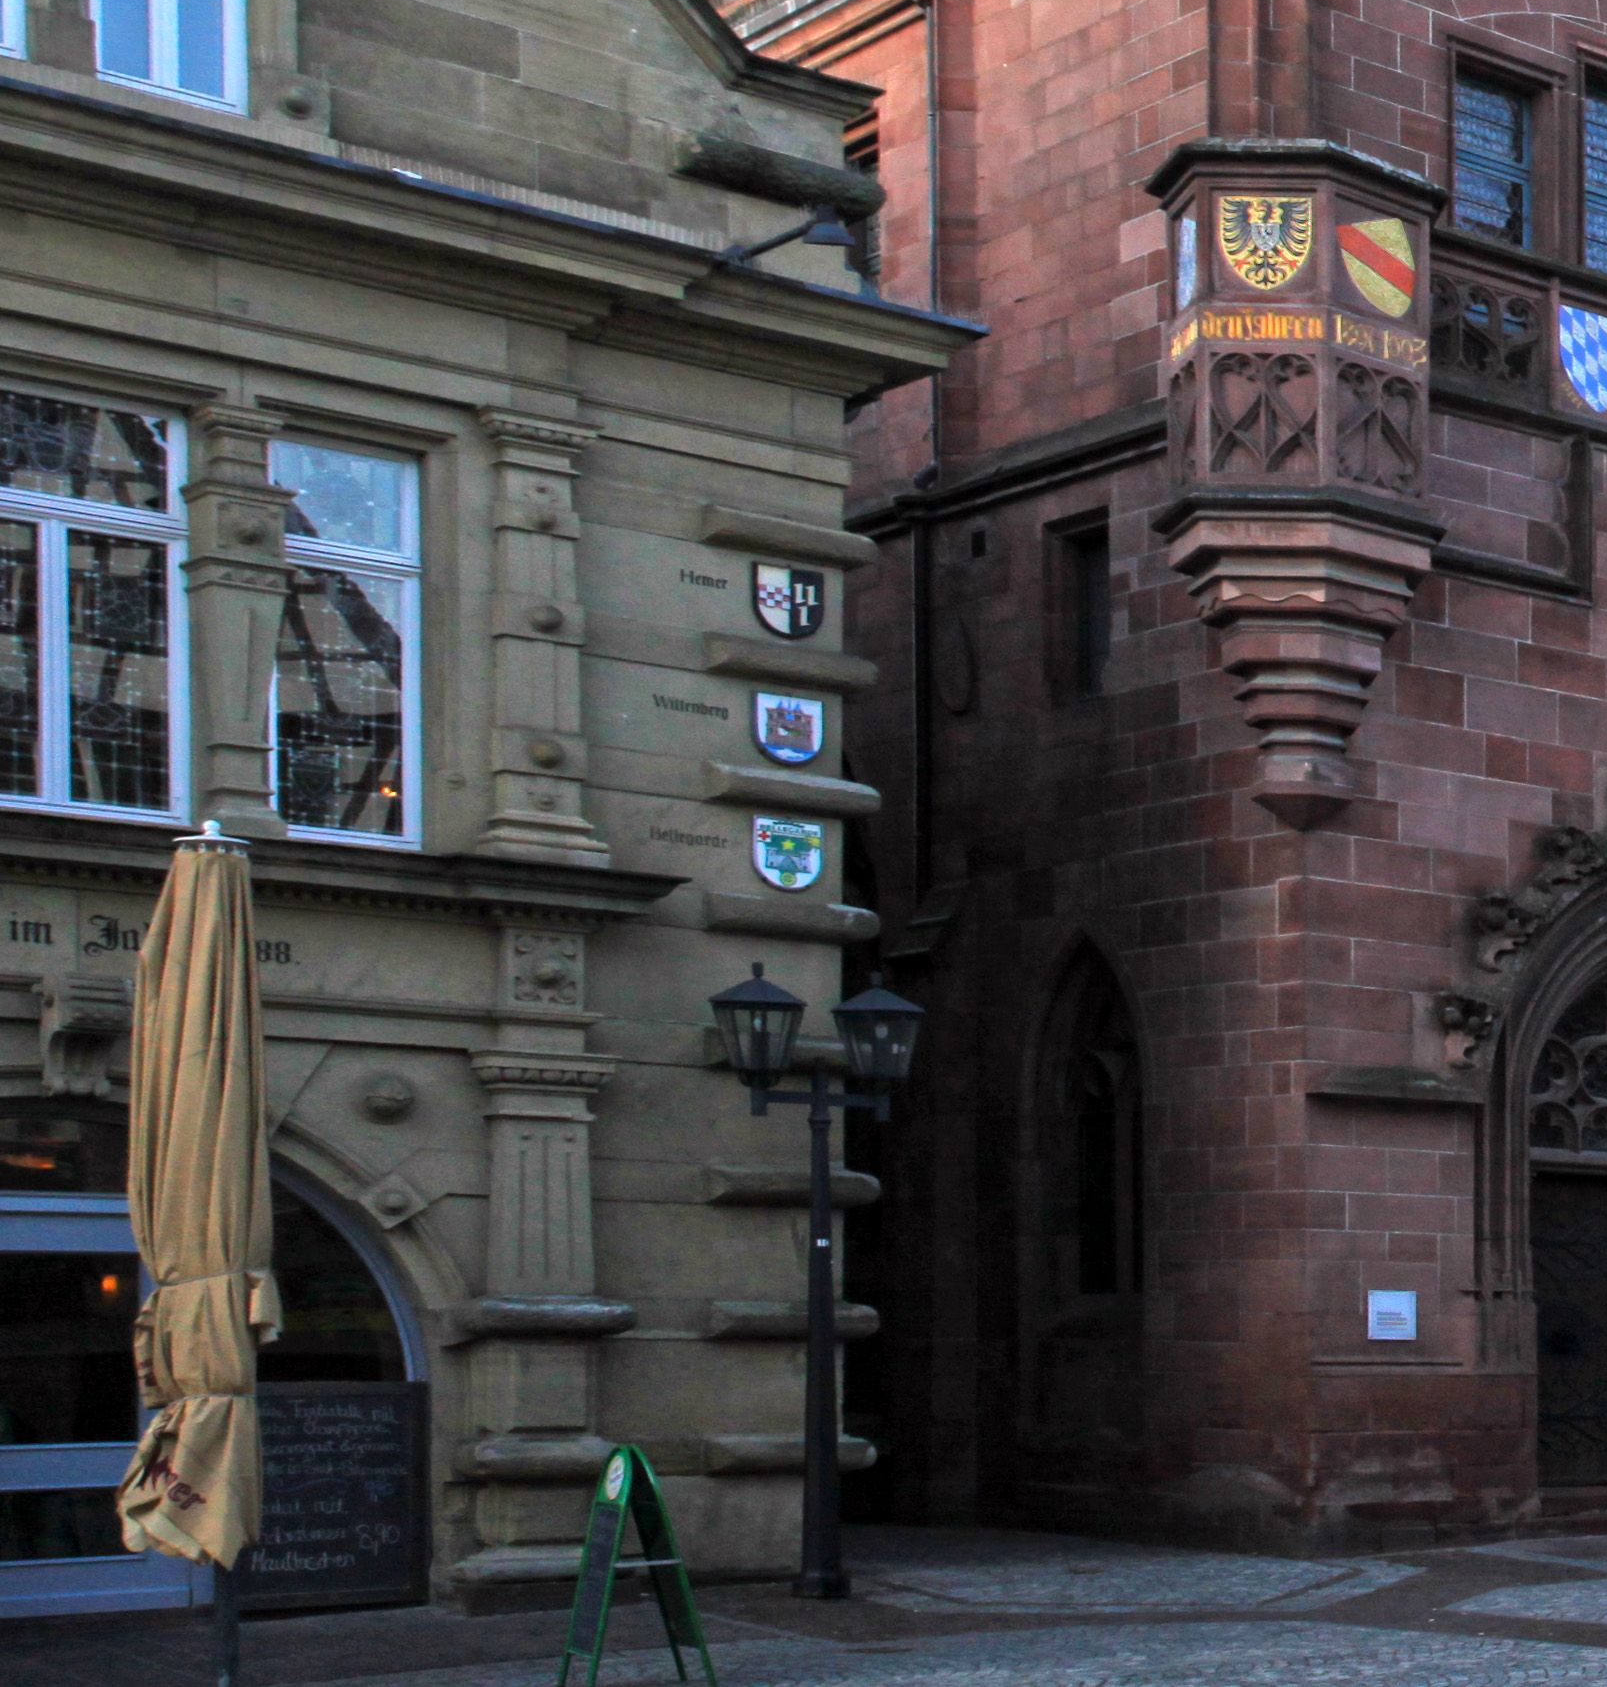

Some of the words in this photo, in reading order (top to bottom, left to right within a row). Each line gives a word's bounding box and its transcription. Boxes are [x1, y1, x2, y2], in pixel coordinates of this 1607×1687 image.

[680, 569, 728, 589] Hemer
[652, 694, 729, 720] Wittenberg
[9, 913, 53, 944] im
[84, 914, 149, 957] Ja
